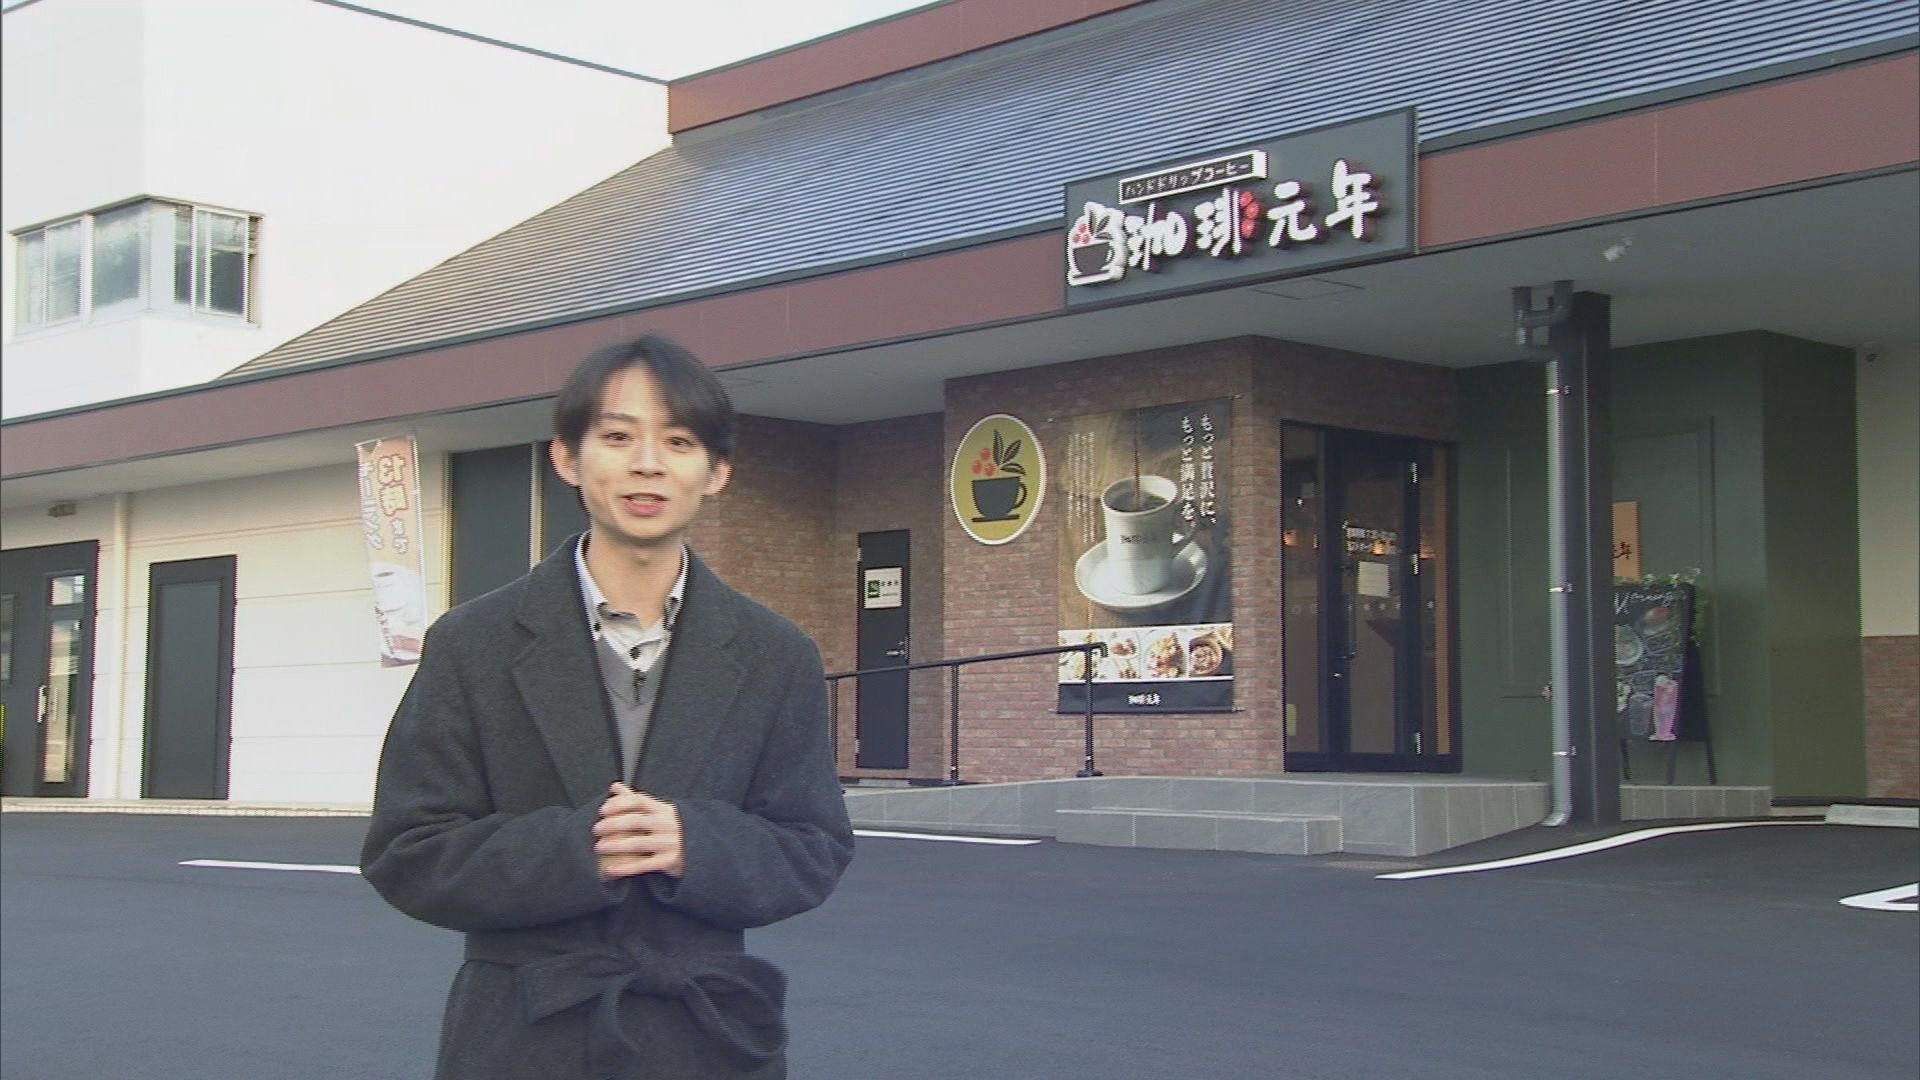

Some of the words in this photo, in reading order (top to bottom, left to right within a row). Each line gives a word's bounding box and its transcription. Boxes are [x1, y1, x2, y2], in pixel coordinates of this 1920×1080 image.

[1123, 158, 1380, 271] 珈琲元年
[1124, 160, 1253, 200] ハンドドリップコーヒー
